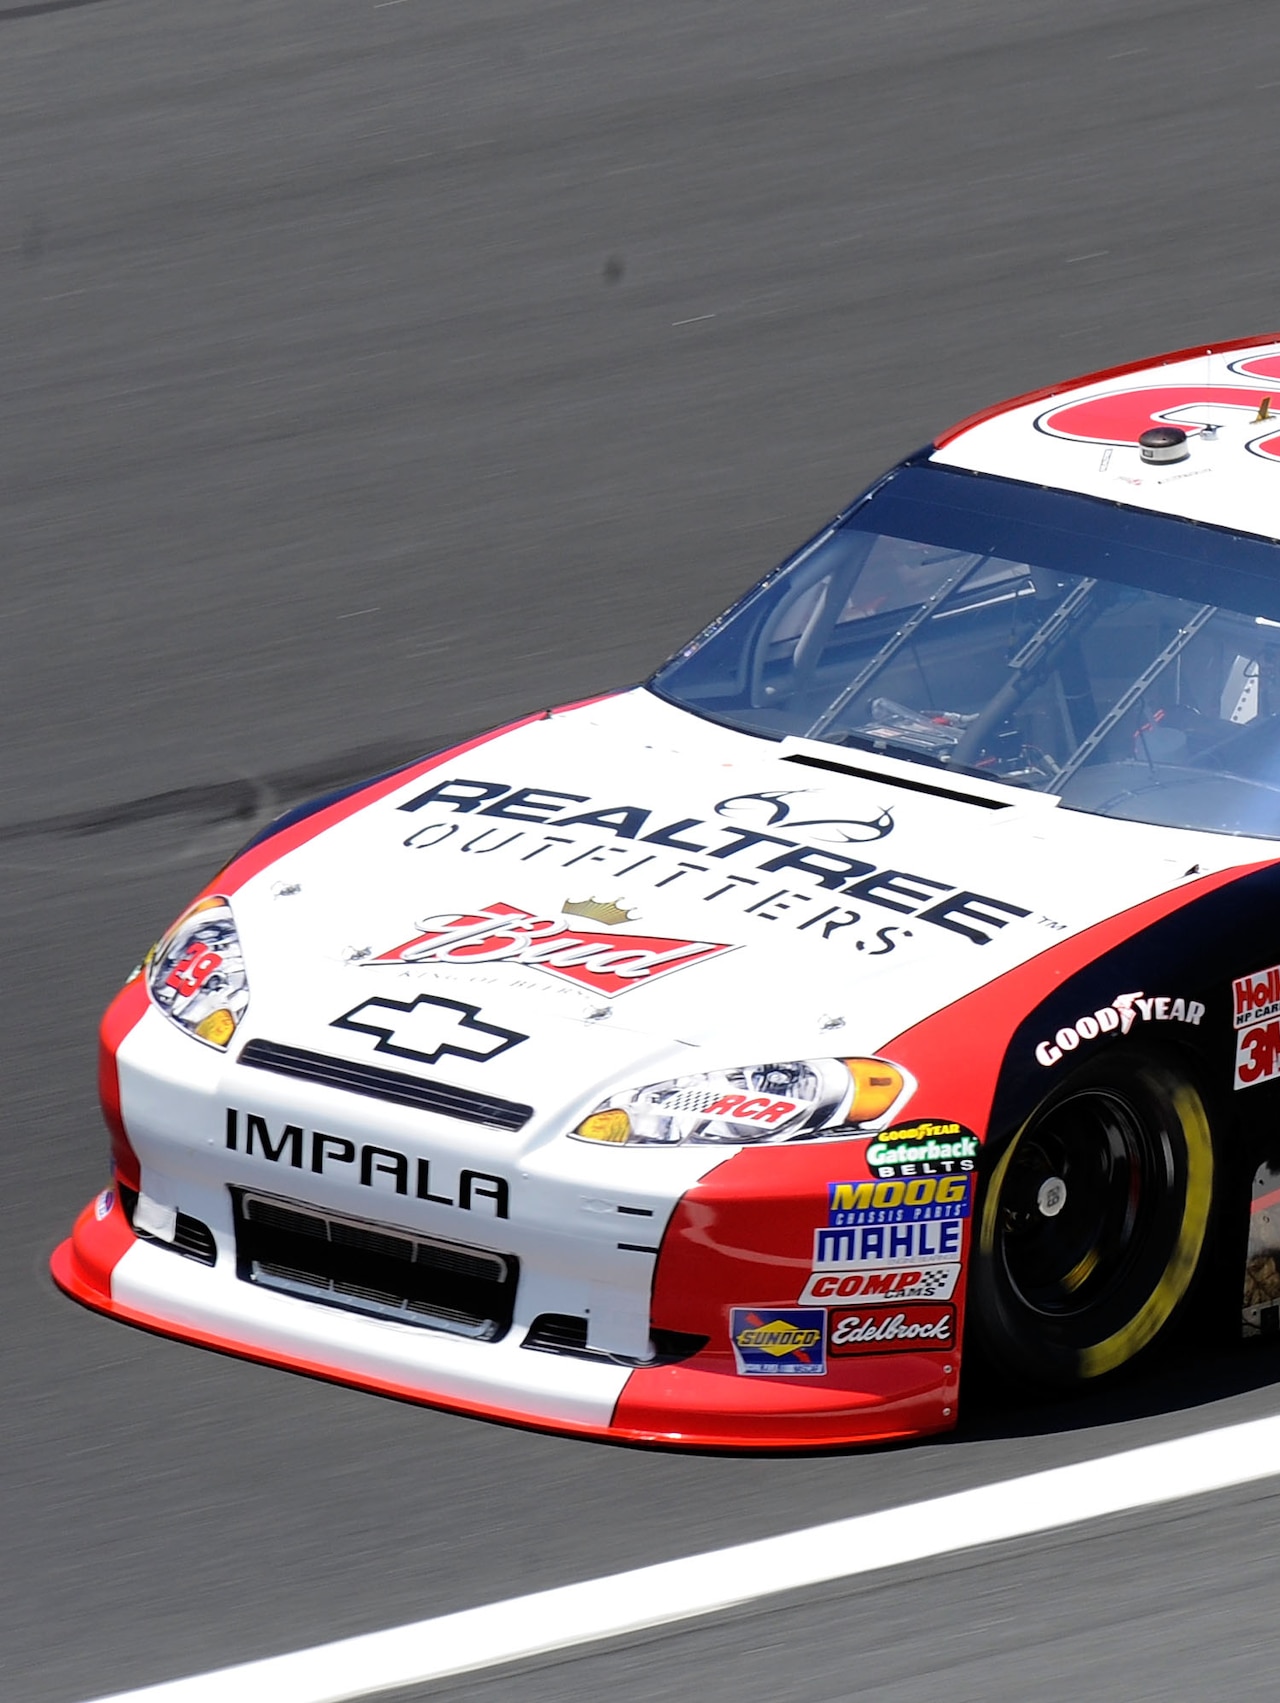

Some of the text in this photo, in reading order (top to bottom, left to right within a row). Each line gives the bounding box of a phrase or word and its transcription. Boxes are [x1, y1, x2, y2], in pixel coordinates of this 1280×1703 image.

[396, 779, 1034, 945] REALTREE
[403, 823, 914, 956] OUTFITTERS
[399, 913, 717, 978] Bud
[165, 941, 224, 998] 29
[1236, 1011, 1252, 1025] HP
[705, 1094, 796, 1123] RCR
[878, 1123, 961, 1142] GOODYEAR
[226, 1108, 510, 1219] IMPALA
[866, 1137, 976, 1166] Gatorback
[879, 1160, 974, 1178] BELTS
[831, 1175, 968, 1210] MOOG
[836, 1204, 962, 1226] CHASSIS PARTS
[817, 1220, 961, 1263] MAHLE
[811, 1271, 922, 1297] COMP
[884, 1287, 936, 1299] CAMS
[741, 1331, 817, 1345] SUNOCO
[831, 1313, 952, 1346] Edelbrock
